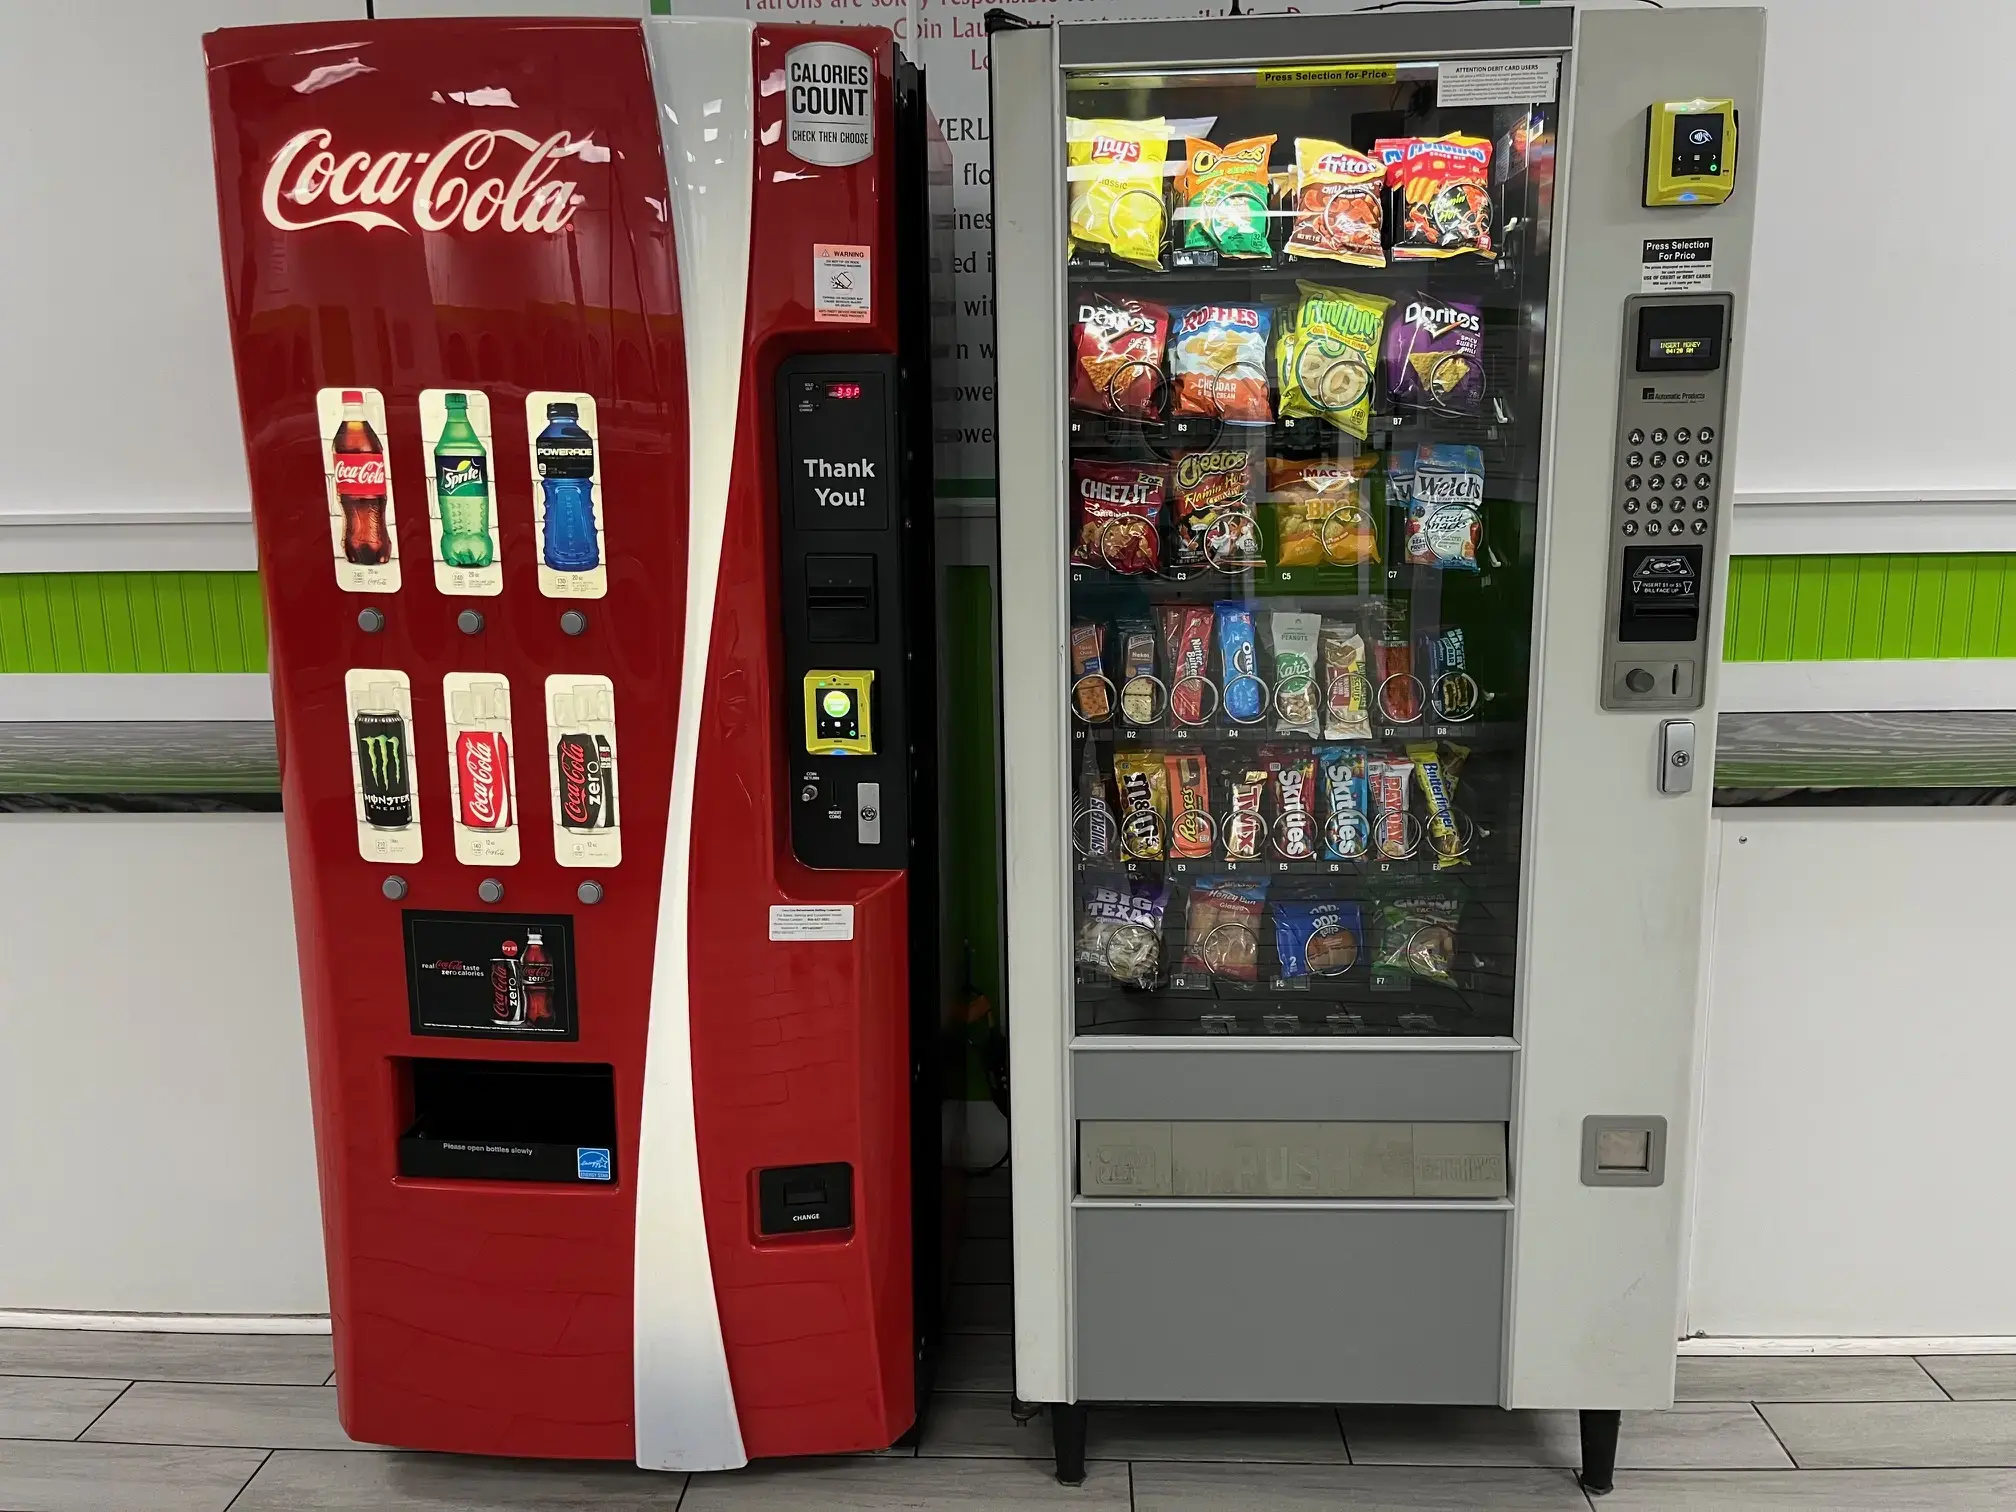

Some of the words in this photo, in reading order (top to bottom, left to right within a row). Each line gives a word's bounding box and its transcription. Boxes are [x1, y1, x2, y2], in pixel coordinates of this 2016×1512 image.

[791, 62, 868, 86] CALORIES
[1264, 72, 1293, 82] Press
[1296, 70, 1346, 81] Selection
[1349, 70, 1360, 80] for
[1361, 70, 1387, 80] Price
[792, 86, 868, 116] COUNT
[792, 129, 816, 142] CHECK
[819, 131, 838, 143] THEN
[840, 132, 868, 145] CHOOSE
[262, 128, 578, 236] Coca-Cola
[1646, 242, 1670, 250] Press
[1672, 240, 1710, 250] Selection
[834, 250, 864, 258] WARNING
[1658, 252, 1673, 260] For
[1674, 252, 1696, 260] Price
[1181, 306, 1259, 334] RUFFLES
[1404, 302, 1480, 332] Doritos
[1456, 339, 1478, 350] SWEET
[1461, 335, 1478, 344] SPICY
[1217, 392, 1236, 400] CREAM
[1285, 419, 1295, 428] B5
[1393, 417, 1402, 426] B7
[1072, 424, 1081, 432] B1
[1178, 424, 1188, 432] B3
[1632, 433, 1640, 442] A
[1654, 432, 1662, 442] B
[1678, 432, 1686, 440] C
[1700, 431, 1710, 440] D
[537, 448, 592, 456] POWERADE
[1630, 456, 1638, 464] E
[1654, 456, 1660, 465] F
[1676, 454, 1684, 464] G
[1700, 454, 1708, 464] H
[335, 460, 385, 485] Coca-Cola
[803, 458, 876, 478] Thank
[1178, 452, 1248, 489] Cheetos
[444, 467, 479, 490] Sprite
[1630, 479, 1635, 487] 1
[1652, 478, 1659, 488] 2
[1675, 478, 1682, 487] 3
[1698, 477, 1705, 486] 4
[1418, 474, 1480, 500] Welch's
[814, 487, 865, 507] You!
[1628, 502, 1634, 510] 5
[1650, 501, 1657, 510] 6
[1674, 501, 1680, 510] 7
[1697, 500, 1703, 509] 8
[1304, 498, 1352, 523] BBQ
[1432, 512, 1464, 525] Fruit
[1627, 524, 1633, 533] 9
[1648, 523, 1658, 532] 10
[1073, 574, 1082, 582] C1
[1178, 572, 1186, 580] C3
[1190, 638, 1202, 667] Nutter
[1448, 649, 1456, 666] BAR
[1186, 651, 1198, 677] Butter
[1279, 660, 1310, 678] Kar's
[465, 737, 496, 823] Coca-Cola
[560, 740, 589, 823] Coca-Cola
[587, 760, 601, 806] zero
[364, 793, 411, 806] MONSTER
[1422, 762, 1454, 830] Butterfinger
[1178, 786, 1197, 843] Reese's
[1278, 770, 1306, 855] Skittles
[1328, 765, 1359, 854] Skittles
[1383, 775, 1404, 845] PAYDAY
[1236, 785, 1259, 851] TWIX
[1090, 797, 1106, 855] SNICKERS
[1096, 887, 1153, 910] BIG
[1208, 889, 1238, 902] Honey
[1239, 895, 1256, 905] Bun
[1220, 902, 1244, 912] Glazed
[1087, 901, 1155, 929] TEXAS
[421, 962, 435, 970] real
[1289, 956, 1297, 966] 2
[1276, 980, 1284, 988] F5
[509, 977, 517, 1007] zero
[443, 1142, 466, 1151] Please
[467, 1145, 484, 1153] open
[486, 1145, 510, 1153] bottles
[511, 1147, 532, 1156] slowly
[792, 1213, 820, 1222] CHANGE
